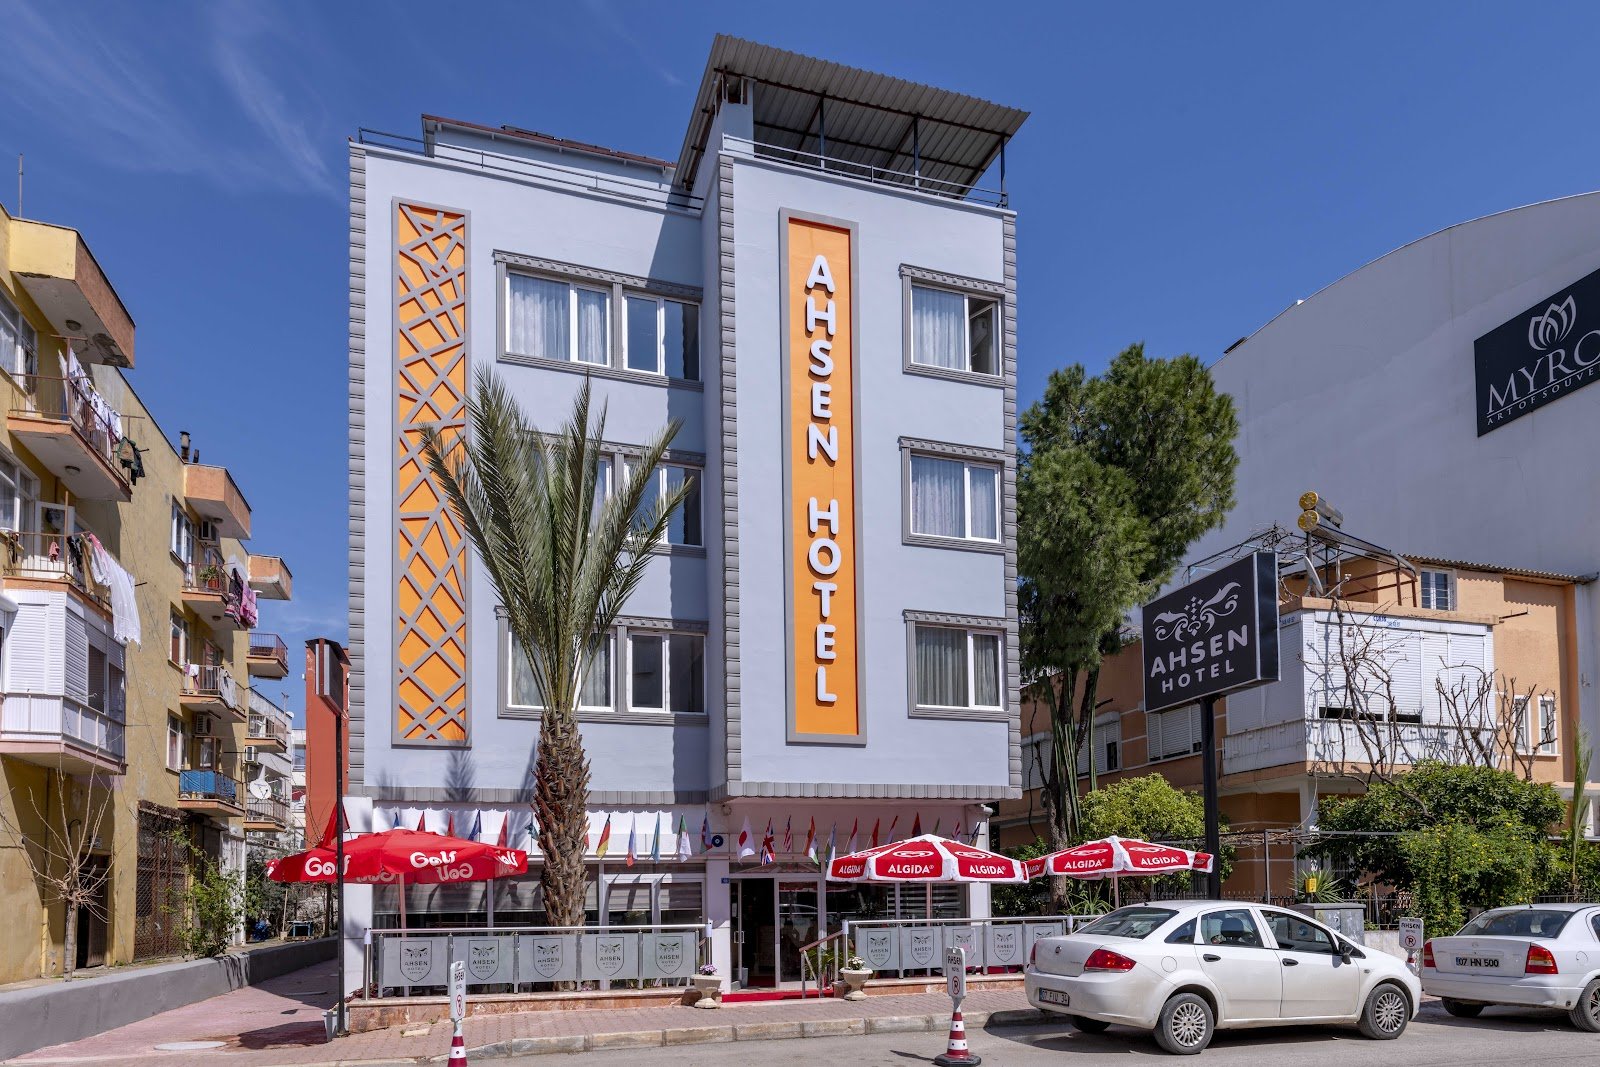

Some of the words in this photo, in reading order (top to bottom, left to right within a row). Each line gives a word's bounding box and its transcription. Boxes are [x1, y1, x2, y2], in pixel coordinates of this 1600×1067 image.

[806, 254, 838, 462] AHSEN
[1487, 407, 1513, 425] ART
[1519, 396, 1536, 409] OF
[1543, 365, 1600, 398] SOUVE
[807, 497, 842, 703] HOTEL
[1150, 624, 1248, 678] AHSEN
[1162, 660, 1235, 693] HOTEL
[304, 854, 351, 877] Gof
[409, 850, 457, 868] Golf
[1064, 859, 1103, 870] ALGIDA
[1140, 856, 1179, 866] ALGIDA
[1470, 959, 1482, 967] HN
[1484, 959, 1499, 967] 500
